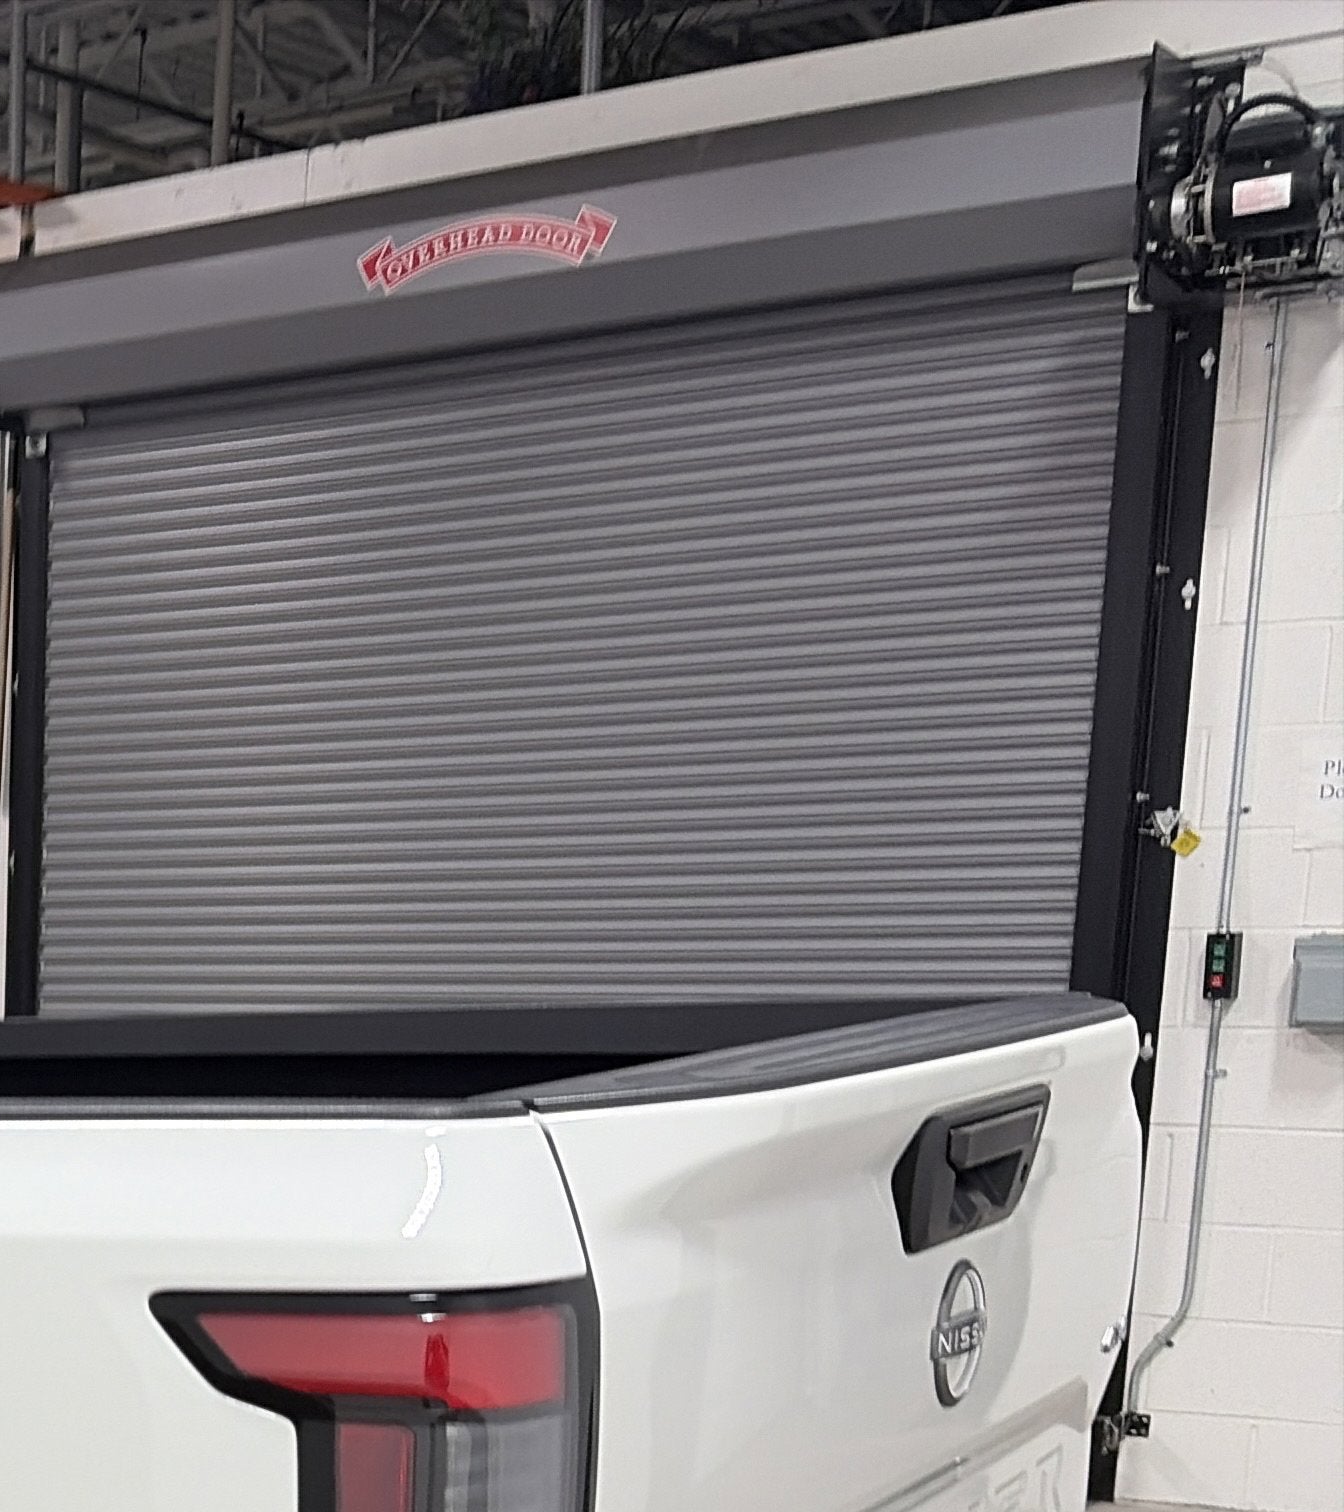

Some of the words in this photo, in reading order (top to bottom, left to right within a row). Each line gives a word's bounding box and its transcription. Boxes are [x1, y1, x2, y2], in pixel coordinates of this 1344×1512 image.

[386, 223, 513, 281] OVERHEAD
[520, 223, 583, 257] DOOR
[1324, 759, 1344, 777] Pl
